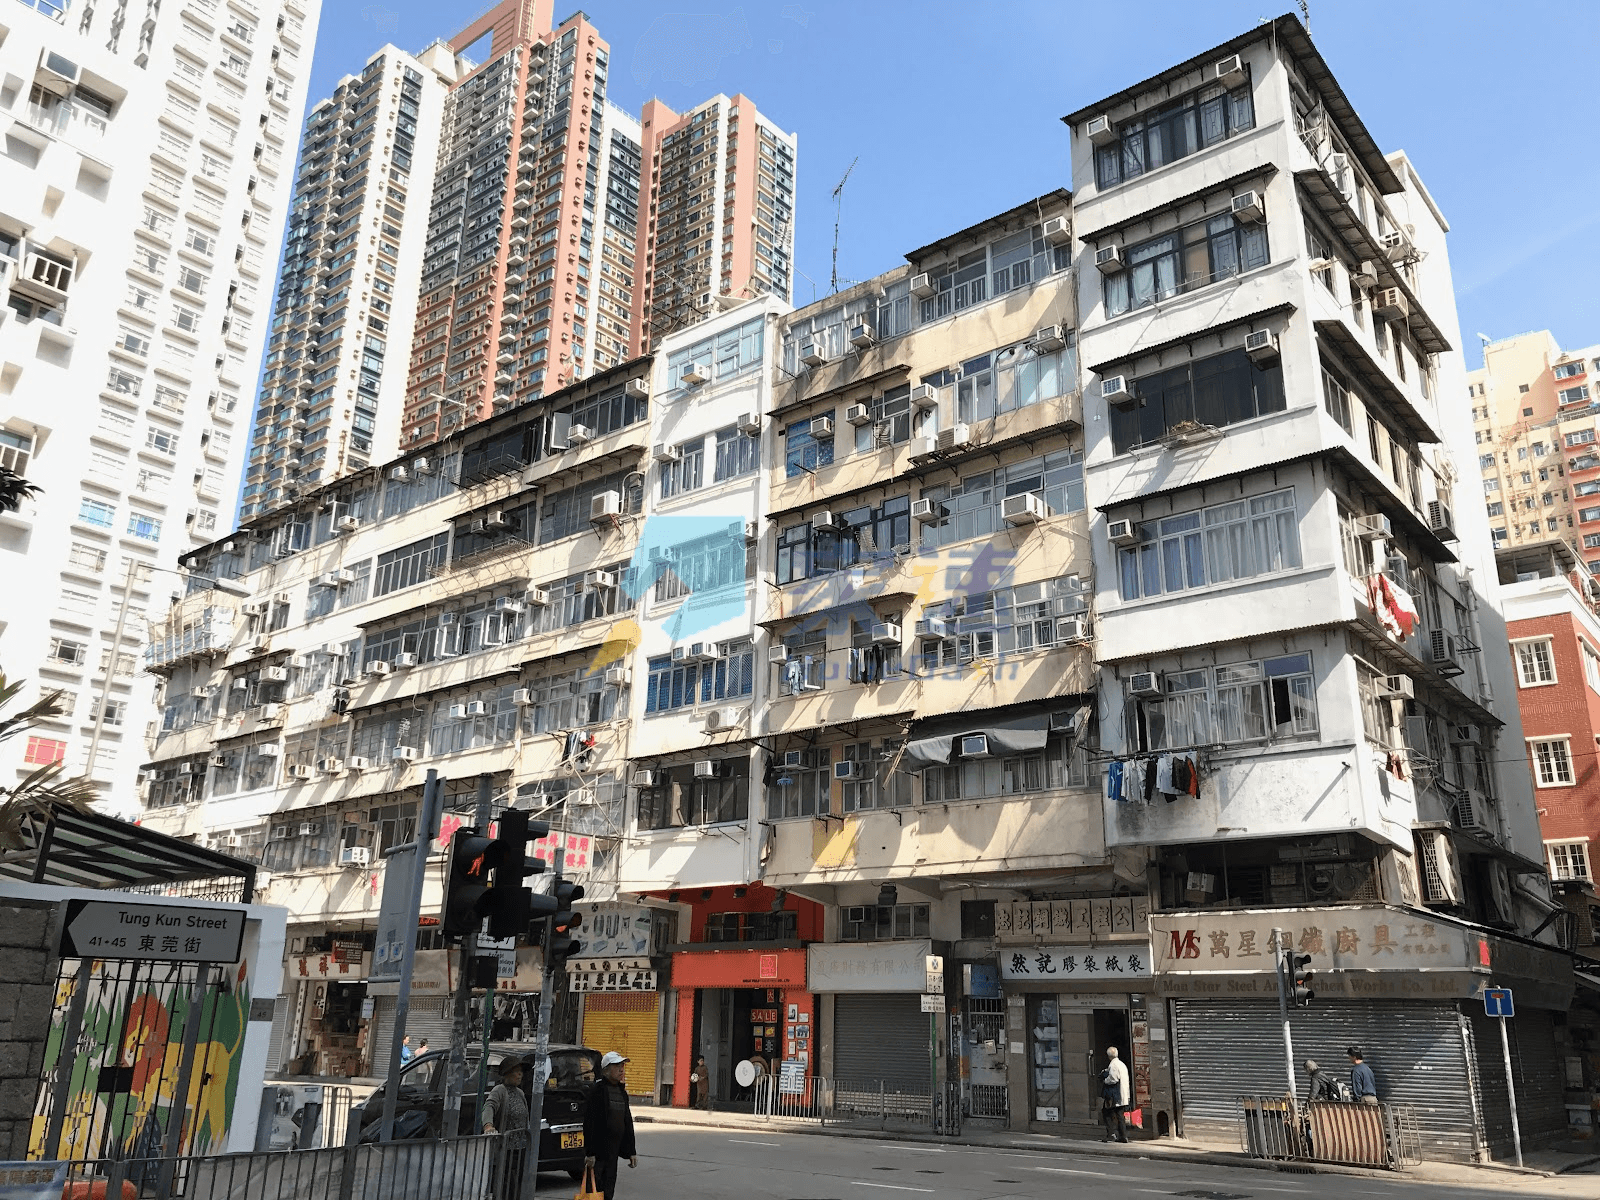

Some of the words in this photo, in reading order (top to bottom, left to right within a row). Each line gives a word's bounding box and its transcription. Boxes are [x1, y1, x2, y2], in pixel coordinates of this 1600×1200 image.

[118, 911, 150, 927] Tung
[155, 913, 181, 927] Kun
[186, 916, 227, 929] Street
[137, 934, 202, 954] 東莞街
[1163, 980, 1188, 992] Man
[1192, 979, 1222, 992] Star
[1227, 979, 1258, 992] Steel
[1432, 977, 1460, 993] Ltd.
[257, 1011, 267, 1019] 45
[751, 1011, 777, 1021] SALE
